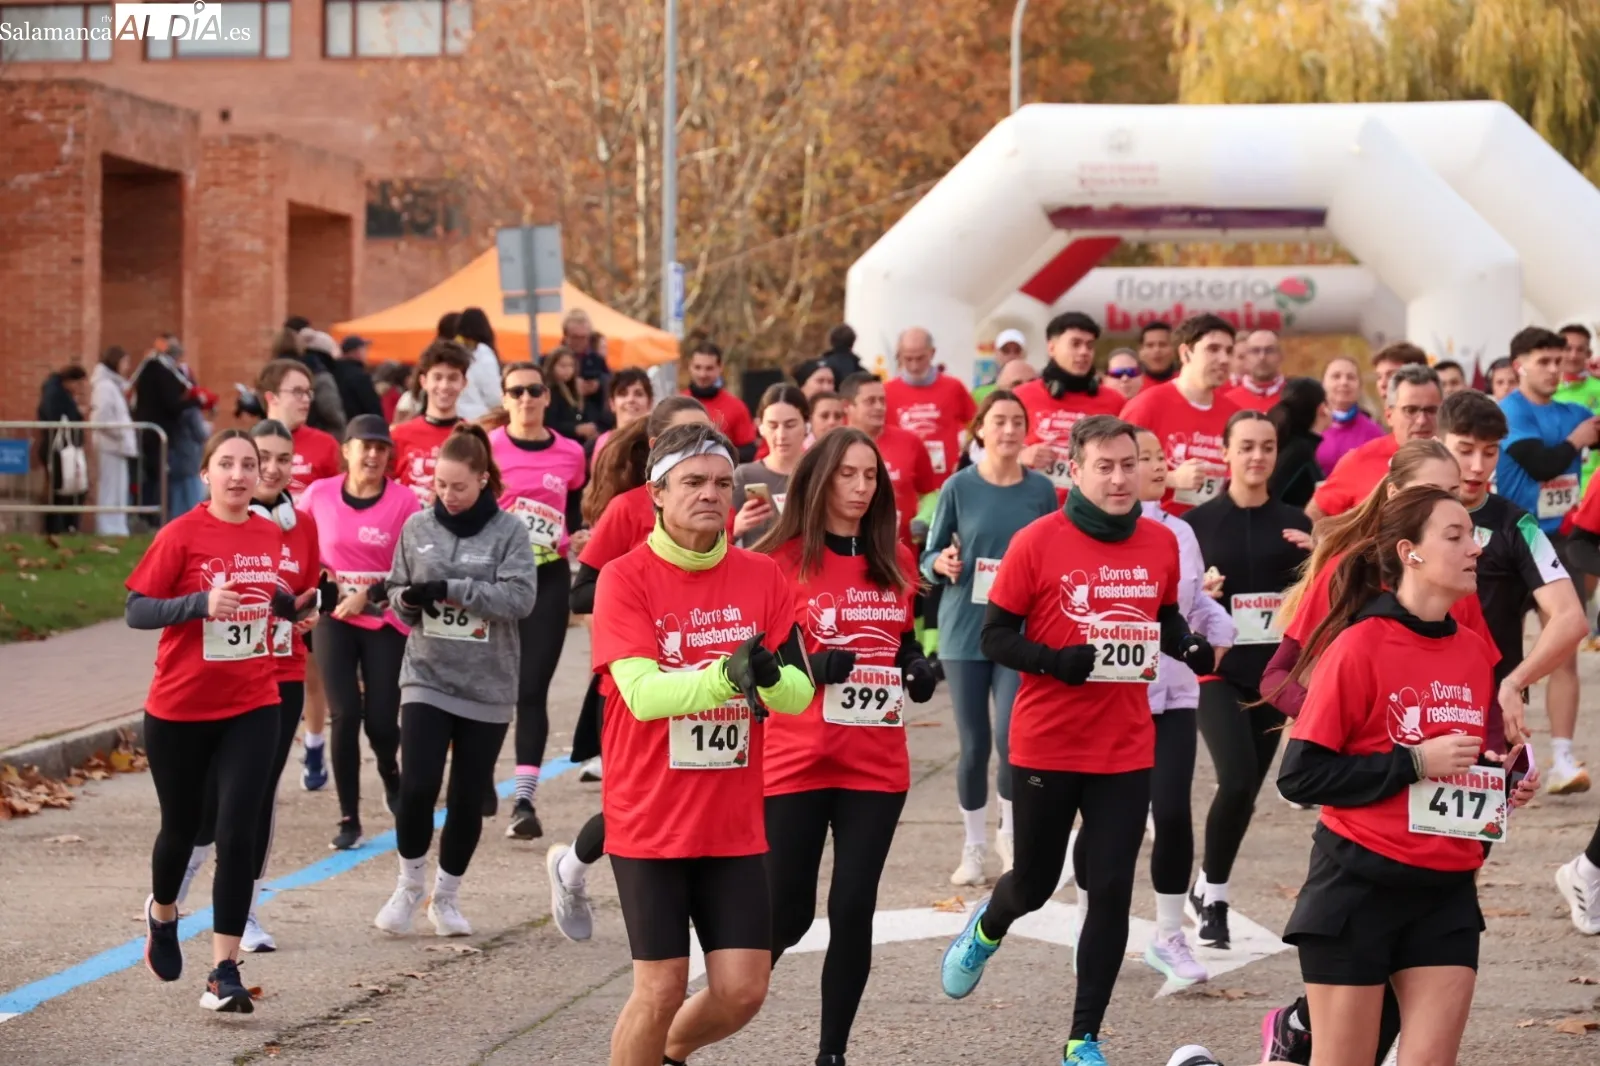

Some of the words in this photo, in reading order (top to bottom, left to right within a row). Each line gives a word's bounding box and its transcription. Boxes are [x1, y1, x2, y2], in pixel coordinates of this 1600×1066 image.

[1546, 488, 1572, 507] 335
[526, 515, 555, 537] 324
[1098, 565, 1131, 582] ¡Corre
[1132, 564, 1149, 580] sin
[845, 587, 879, 604] ¡Corre
[1093, 581, 1159, 599] resistencias!
[442, 607, 469, 627] 56
[689, 607, 721, 628] ¡Corre
[722, 603, 742, 621] sin
[841, 603, 907, 622] resistencias!
[227, 623, 252, 646] 31
[1088, 624, 1160, 641] bedunia
[1101, 643, 1146, 667] 200
[841, 686, 889, 710] 399
[1430, 679, 1461, 702] ¡Corre
[1462, 682, 1472, 704] sin
[690, 724, 739, 751] 140
[1428, 786, 1487, 820] 417
